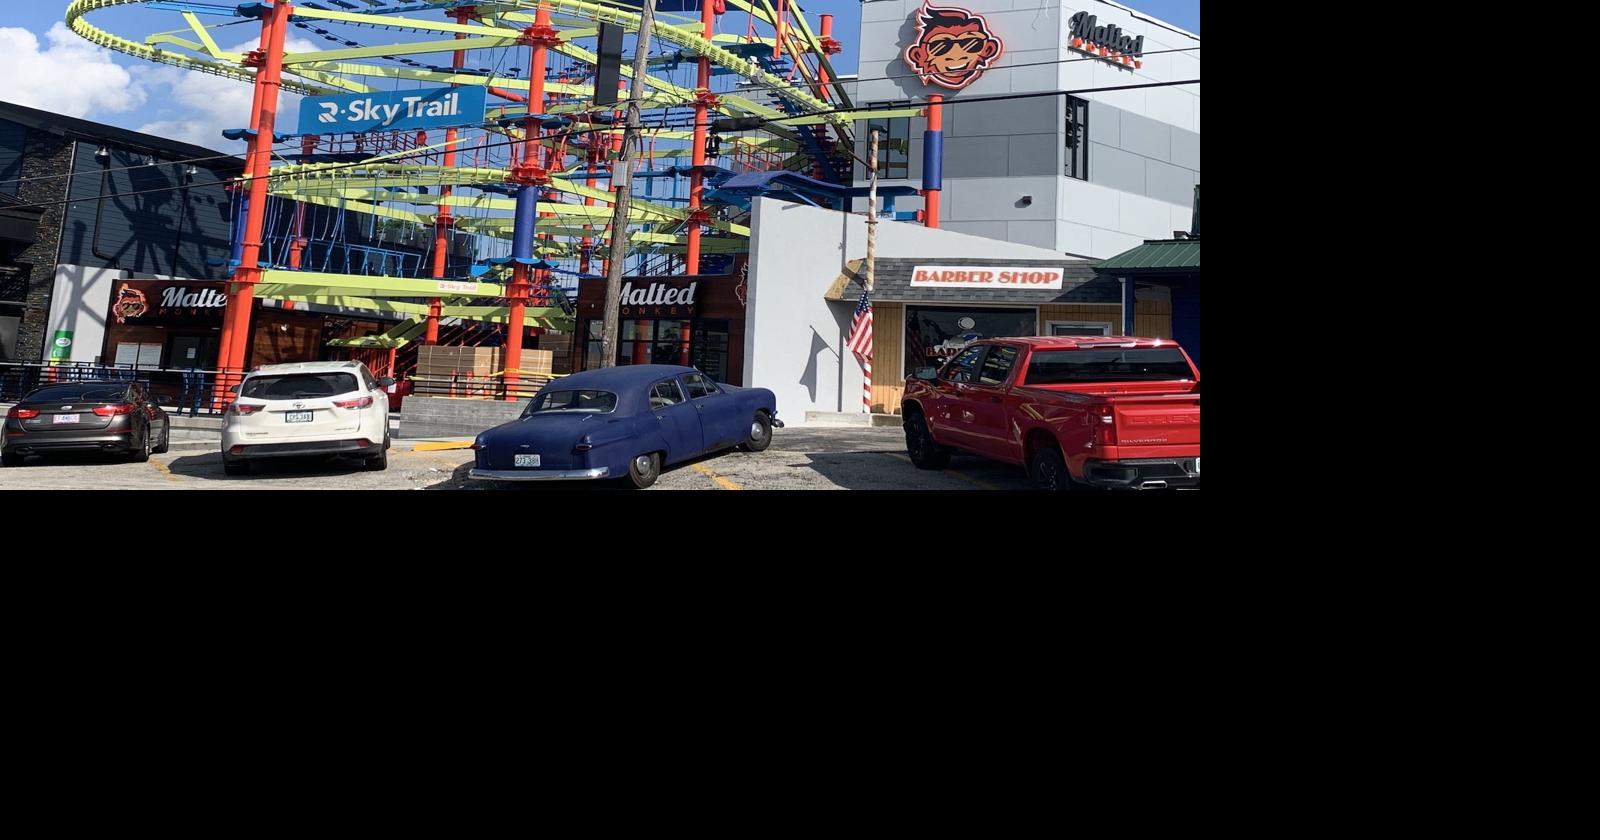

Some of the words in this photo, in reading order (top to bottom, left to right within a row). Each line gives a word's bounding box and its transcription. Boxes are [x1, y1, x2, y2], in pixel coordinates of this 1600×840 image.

[1068, 11, 1144, 57] Malted
[347, 98, 400, 126] Sky
[403, 93, 459, 118] Trail
[914, 270, 994, 283] BARBER
[998, 271, 1060, 284] SHOP
[160, 286, 228, 308] Malte
[622, 306, 695, 315] ONKEY
